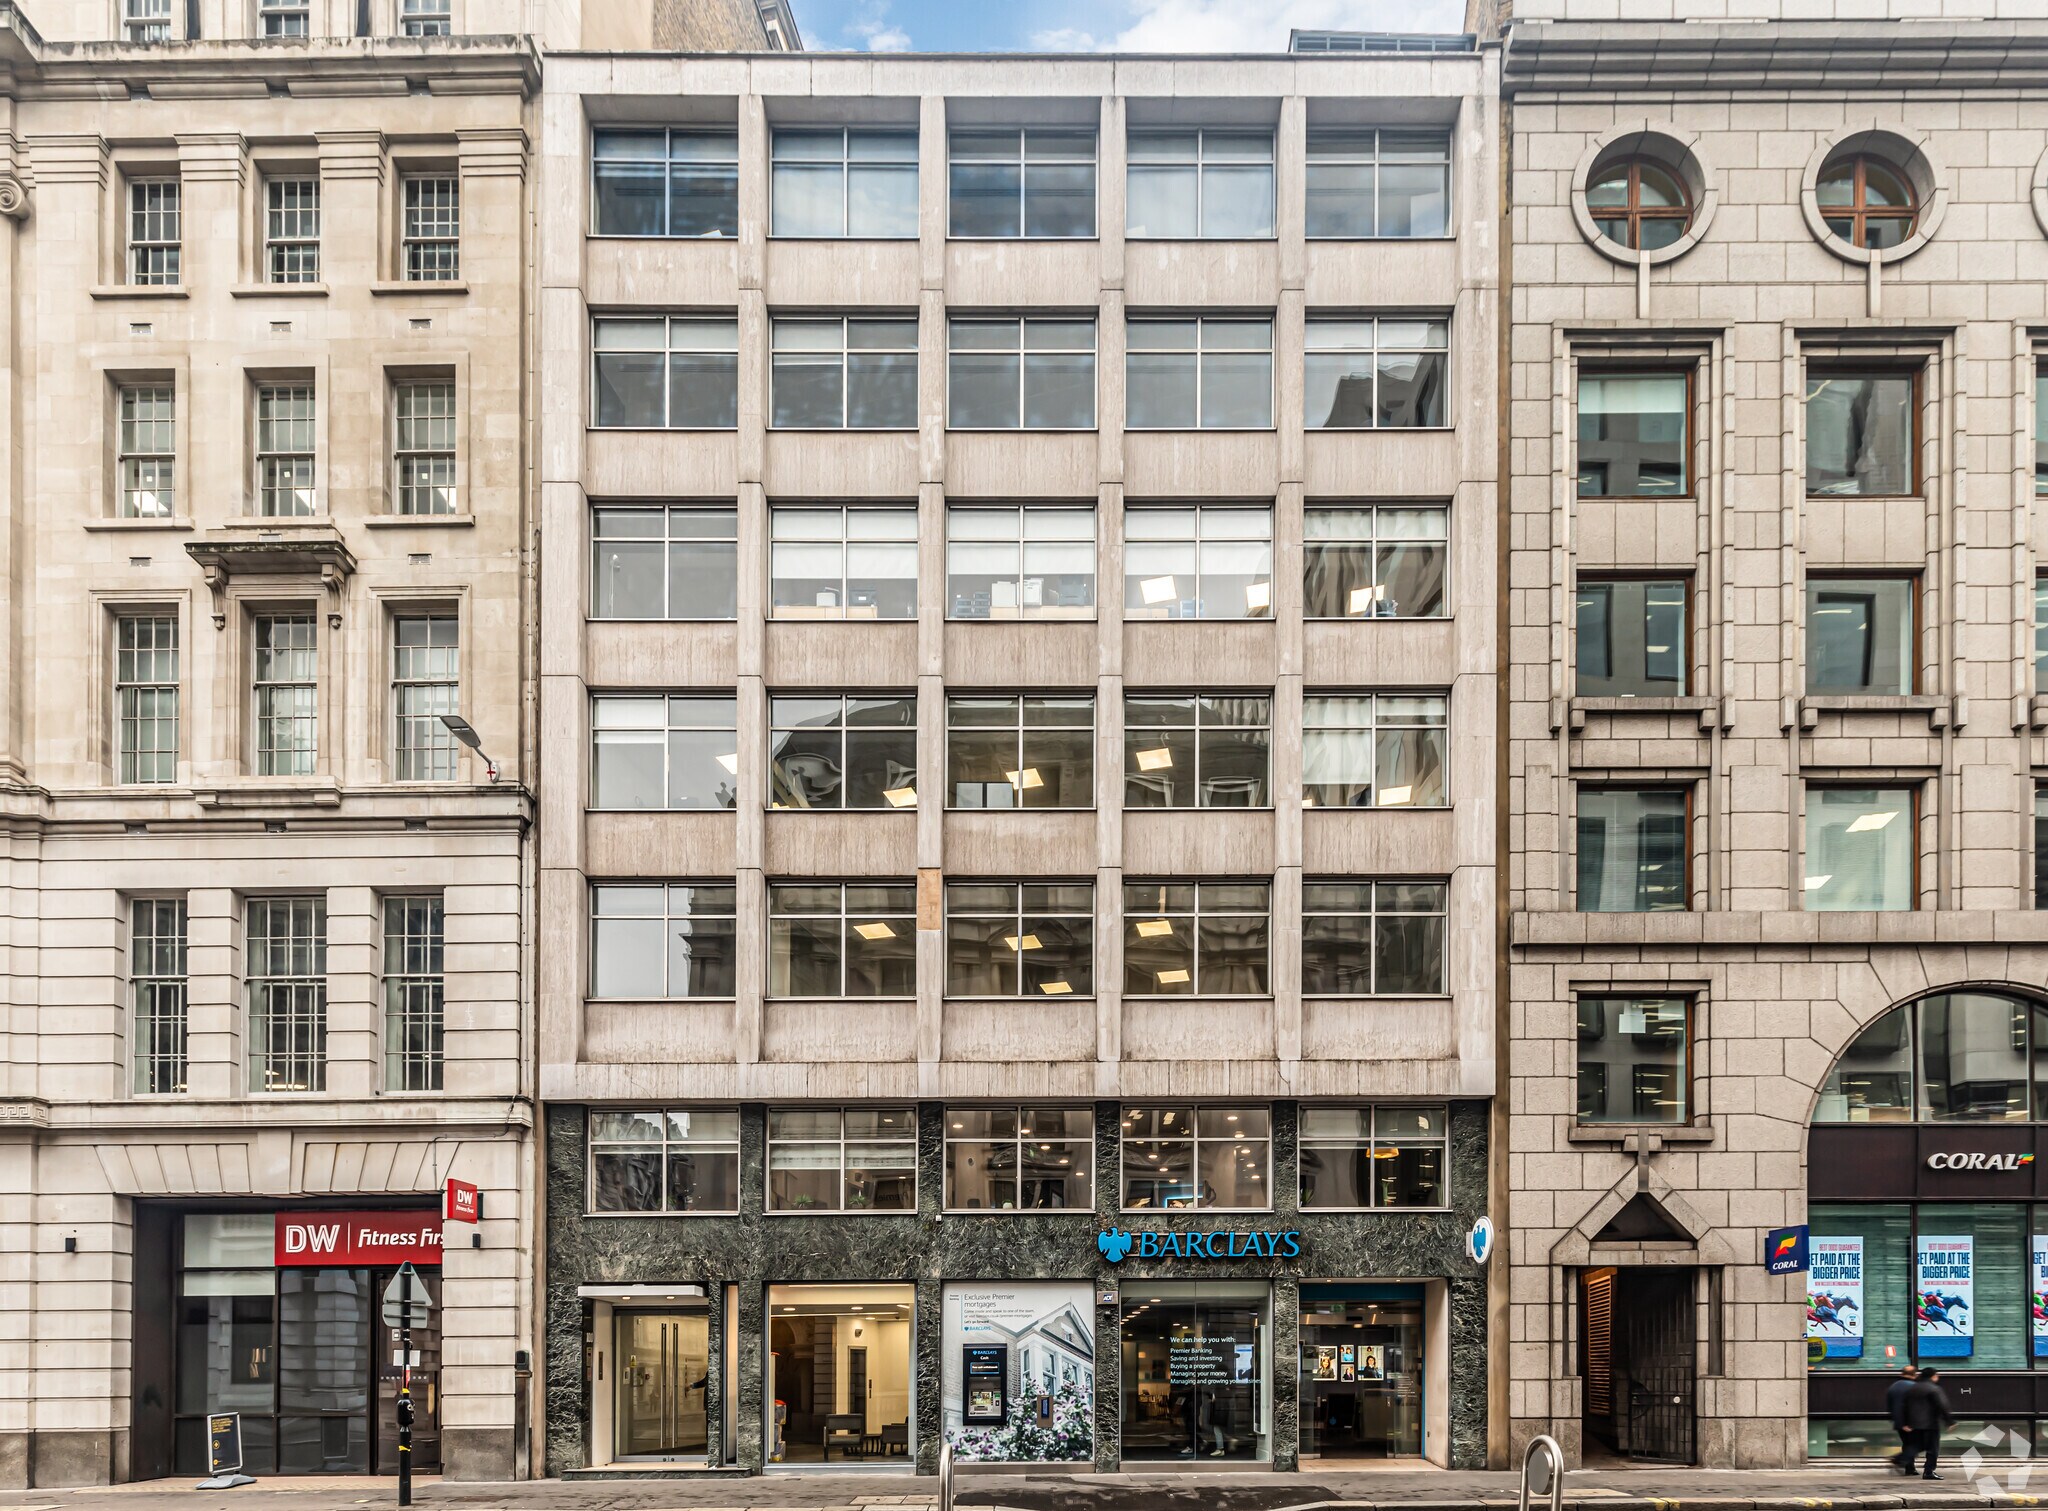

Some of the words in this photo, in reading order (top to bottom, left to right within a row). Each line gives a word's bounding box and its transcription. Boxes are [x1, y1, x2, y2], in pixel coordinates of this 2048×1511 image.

[1927, 1152, 2019, 1171] CORAL
[457, 1189, 474, 1205] DW
[285, 1225, 340, 1253] DW
[358, 1228, 417, 1248] Fitness
[1139, 1231, 1300, 1258] BARCLAYS
[1772, 1260, 1798, 1270] CORAL
[1809, 1252, 1818, 1265] ET
[1820, 1252, 1836, 1265] PAID
[1838, 1252, 1847, 1265] AT
[1847, 1252, 1860, 1265] THE
[1929, 1252, 1946, 1265] PAID
[1947, 1252, 1957, 1265] AT
[1957, 1252, 1970, 1265] THE
[1813, 1267, 1838, 1279] BIGGER
[1840, 1267, 1860, 1279] PRICE
[1922, 1266, 1948, 1278] BIGGER
[1950, 1266, 1970, 1278] PRICE
